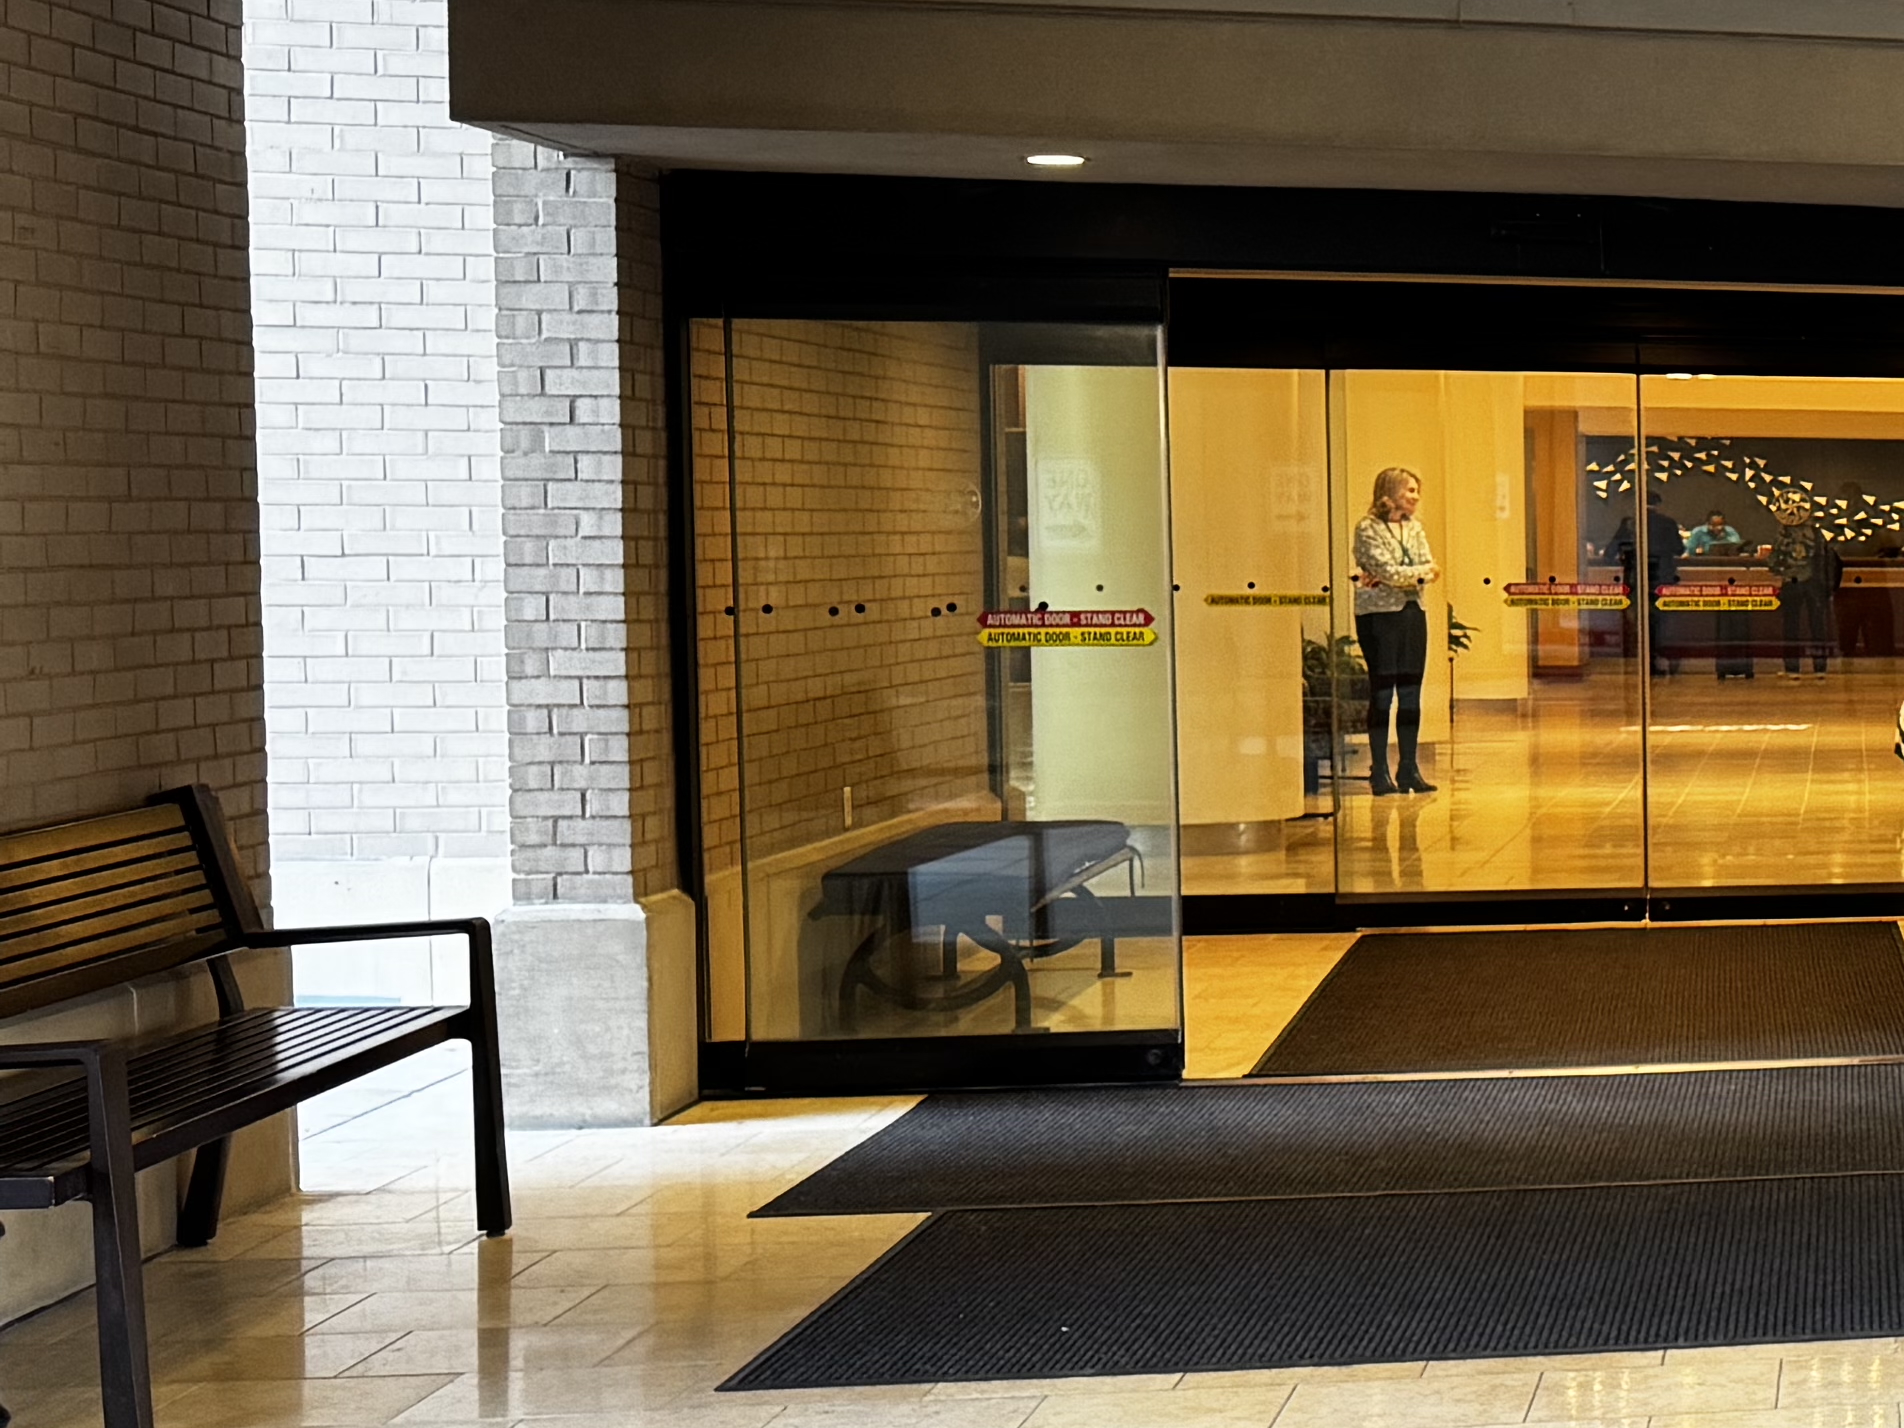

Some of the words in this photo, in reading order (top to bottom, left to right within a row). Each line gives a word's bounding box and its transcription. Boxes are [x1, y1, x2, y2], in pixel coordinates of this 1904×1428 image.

[986, 614, 1042, 625] AUTOMATIC
[1045, 614, 1071, 625] DOOR
[1080, 613, 1111, 625] STAND
[1114, 613, 1145, 625] CLEAR
[987, 632, 1041, 643] AUTOMATIC
[1045, 632, 1071, 643] DOOR
[1080, 631, 1112, 642] STAND
[1114, 631, 1145, 642] CLEAR
